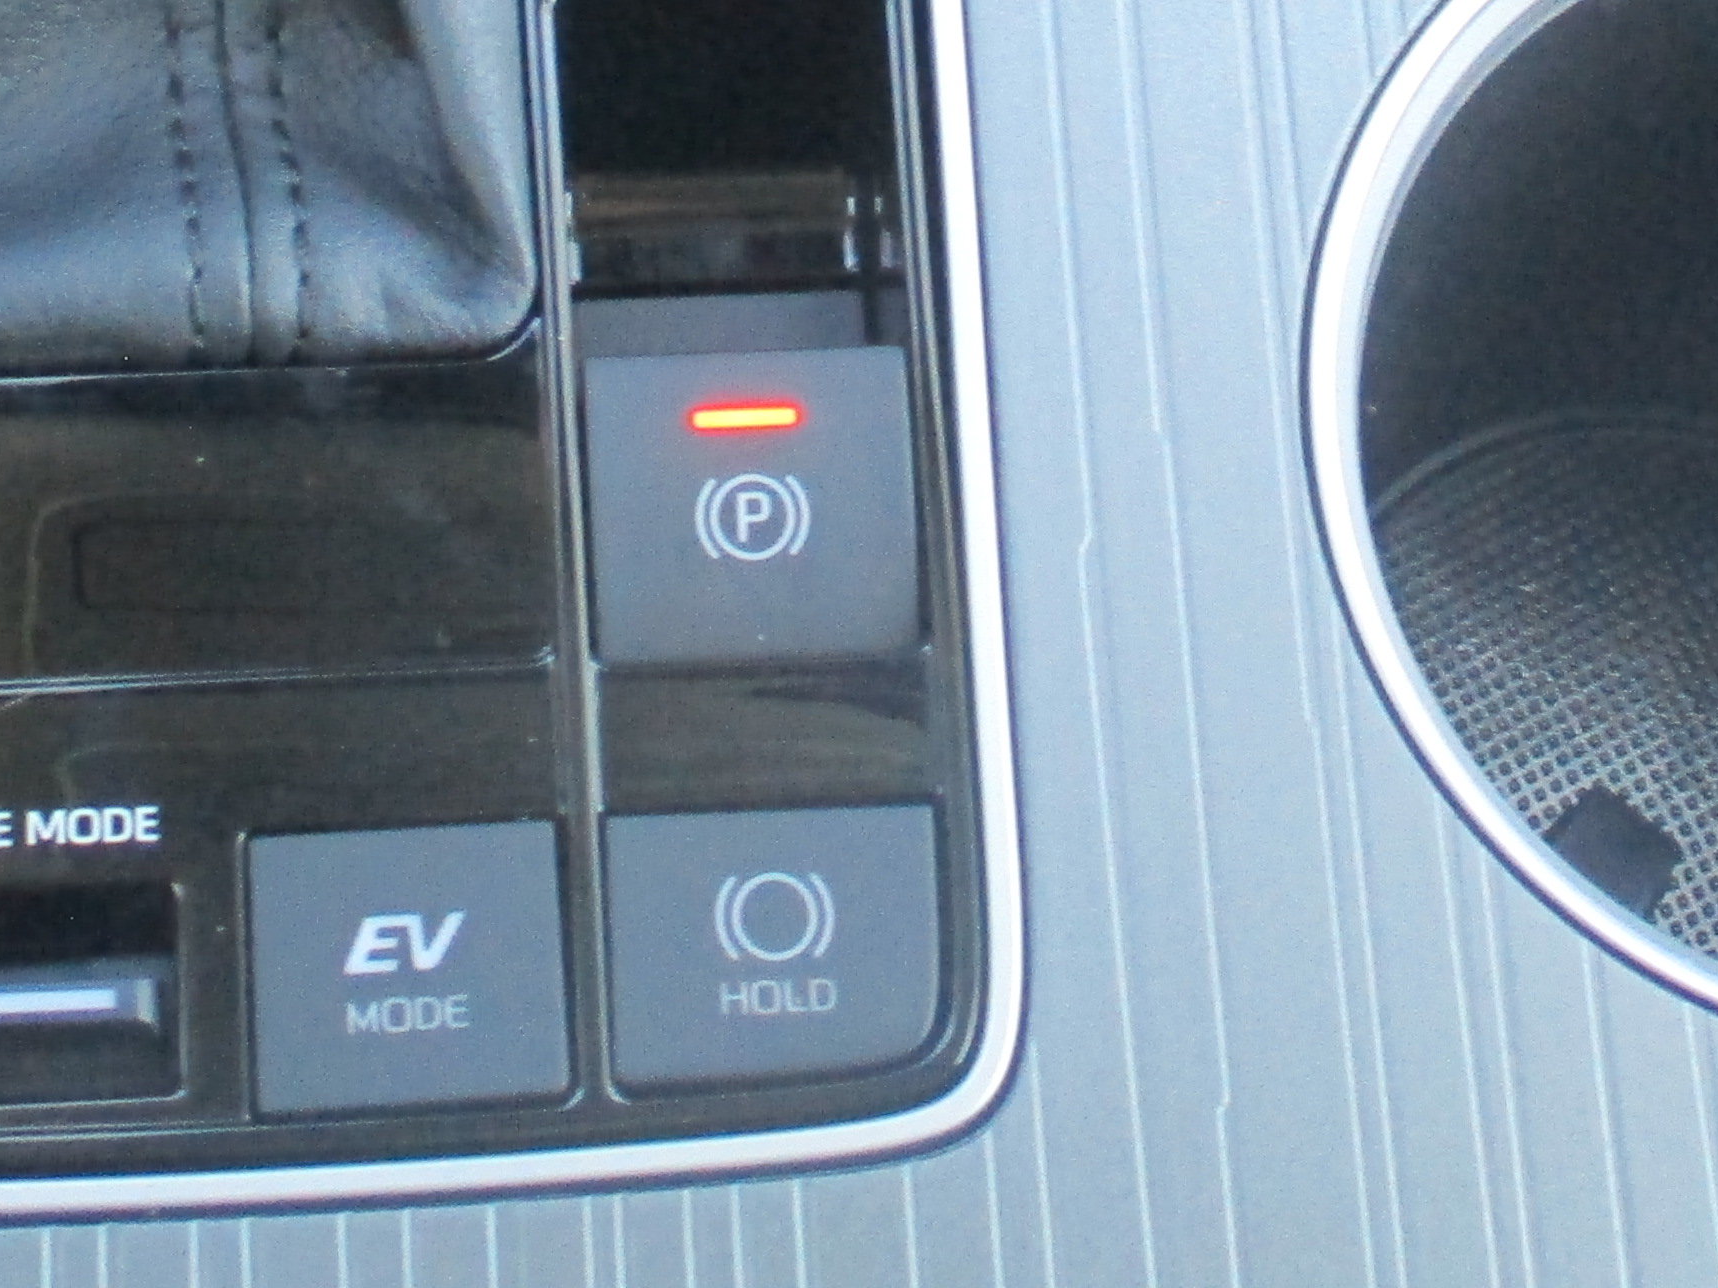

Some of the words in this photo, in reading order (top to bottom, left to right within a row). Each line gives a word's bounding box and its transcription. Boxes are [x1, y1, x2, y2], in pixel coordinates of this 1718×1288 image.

[735, 491, 771, 543] P
[24, 804, 162, 846] MODE
[343, 908, 467, 975] EV
[345, 993, 471, 1037] MODE
[719, 977, 838, 1015] HOLD
